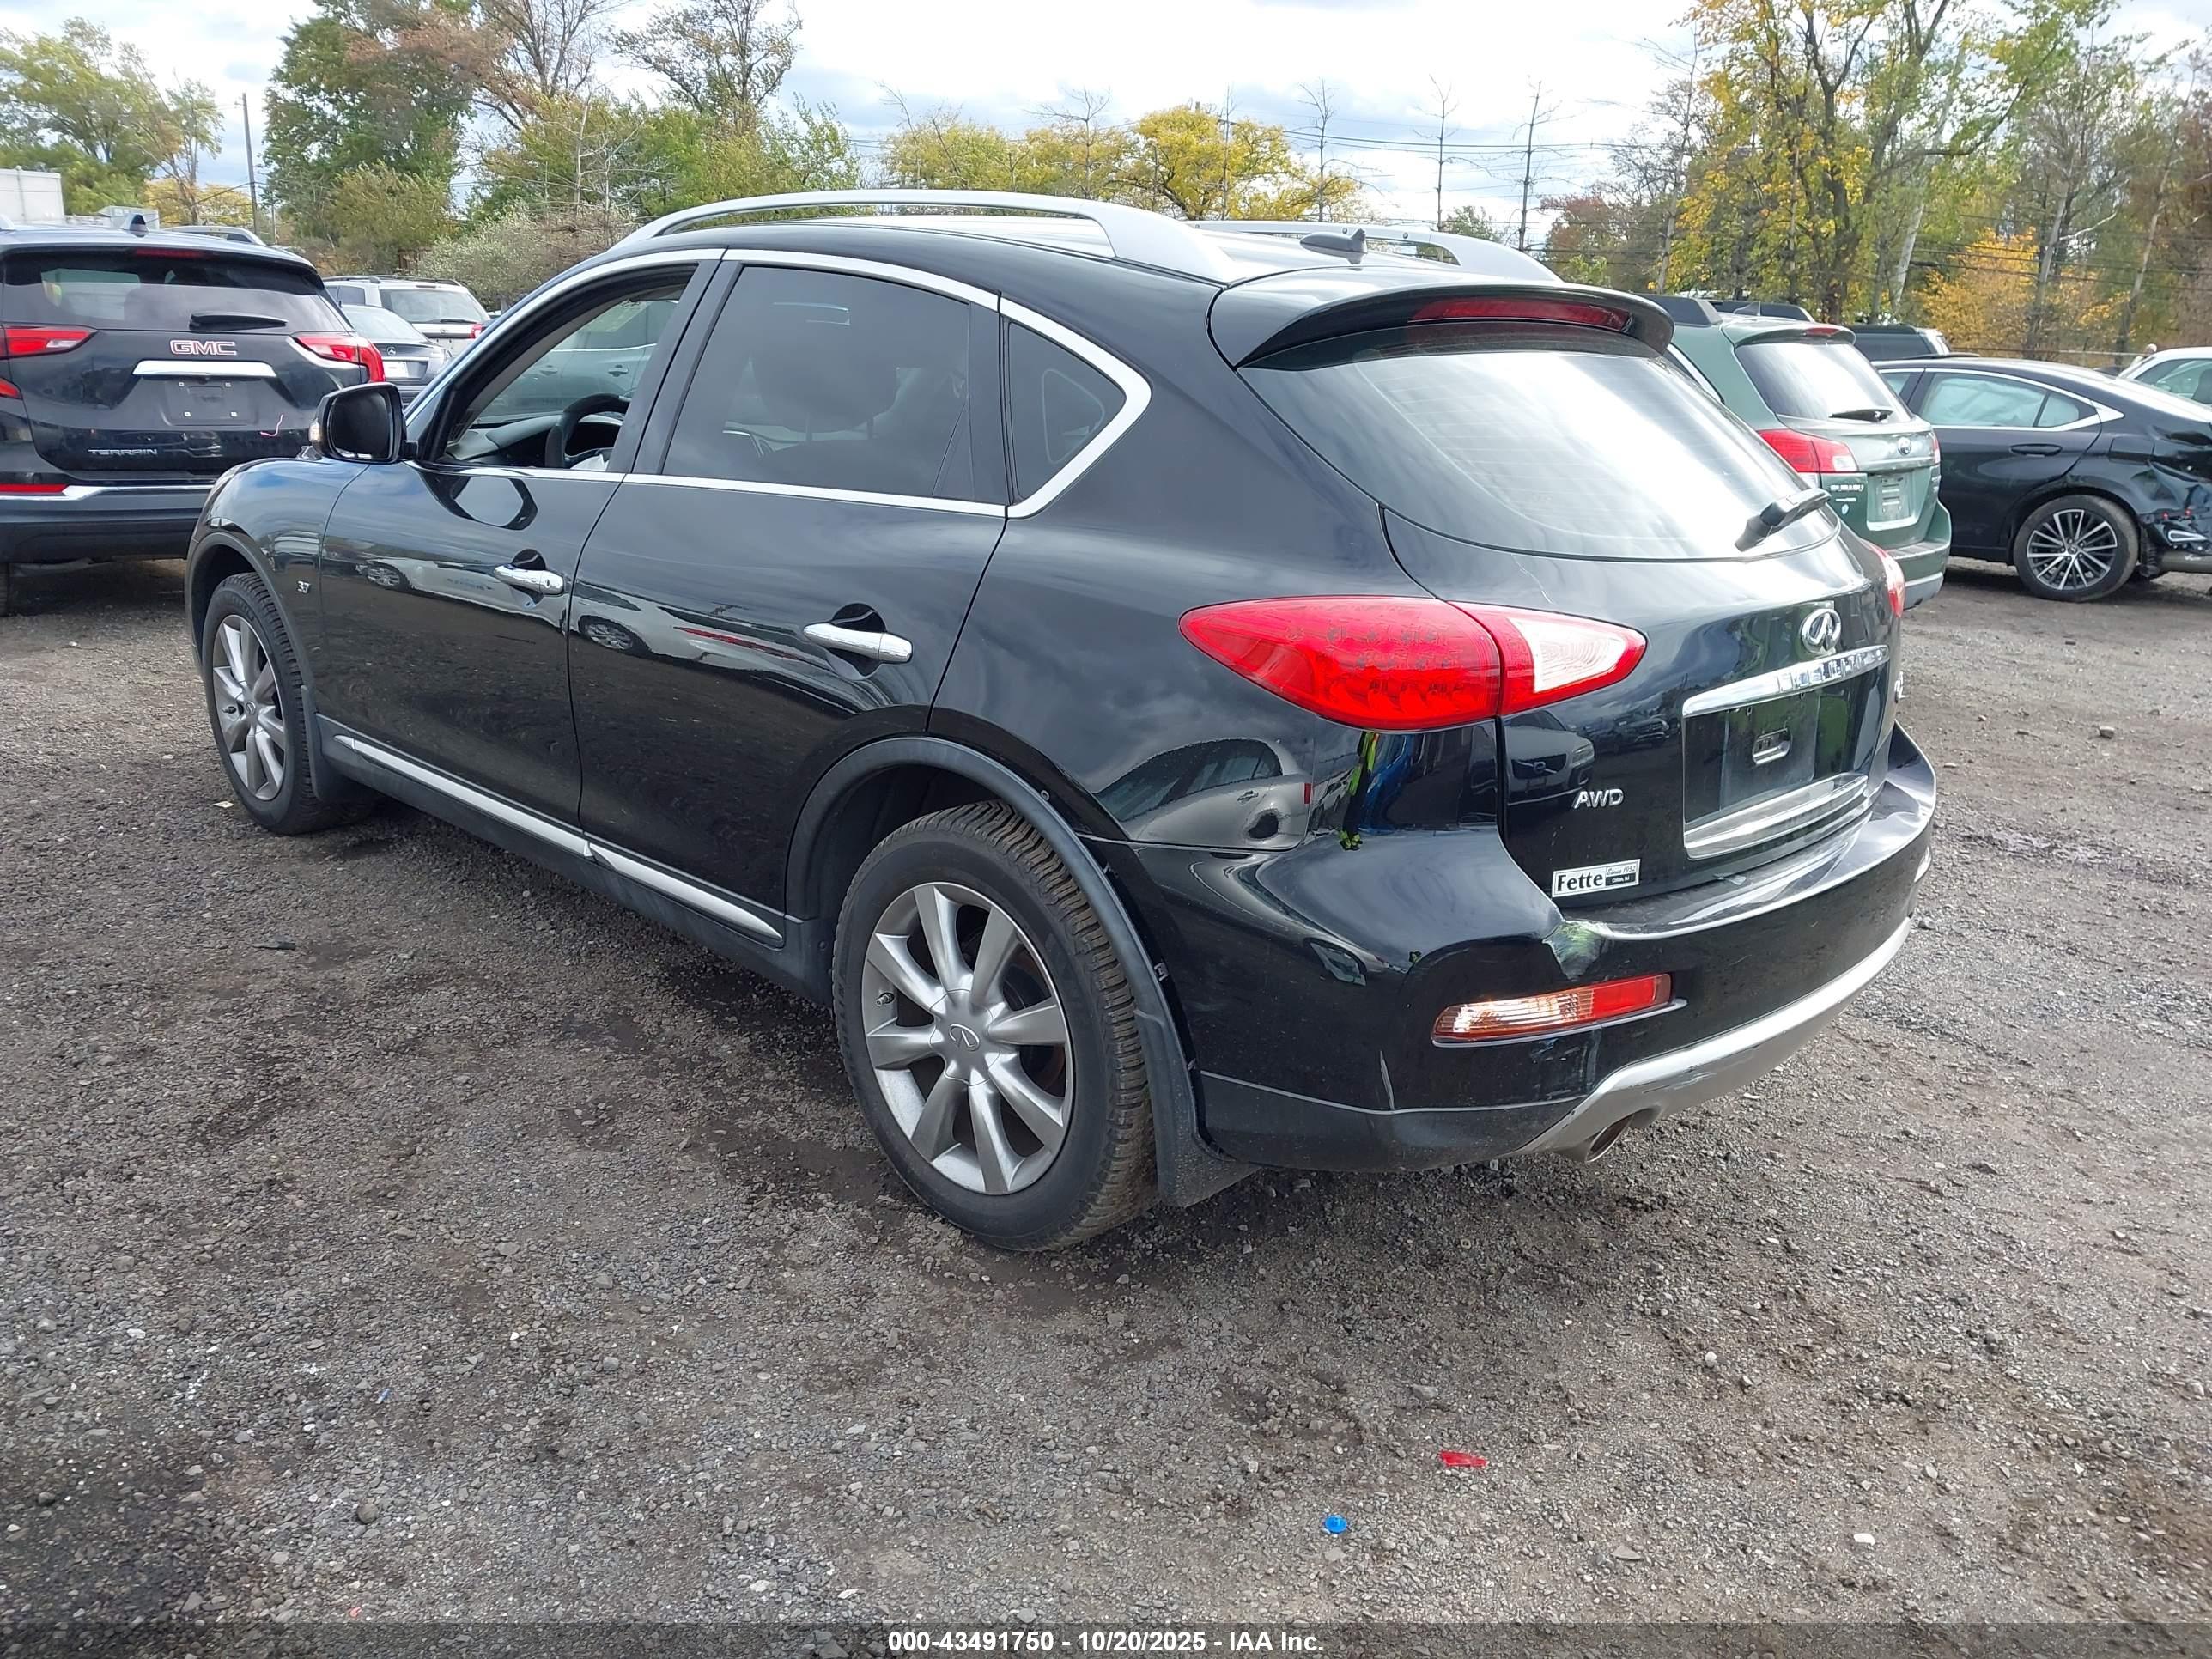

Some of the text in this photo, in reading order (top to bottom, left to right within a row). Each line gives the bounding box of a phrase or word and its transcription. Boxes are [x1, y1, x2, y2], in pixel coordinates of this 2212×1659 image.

[169, 339, 237, 356] GMC
[1572, 788, 1624, 809] AWD
[1557, 872, 1603, 891] Fette
